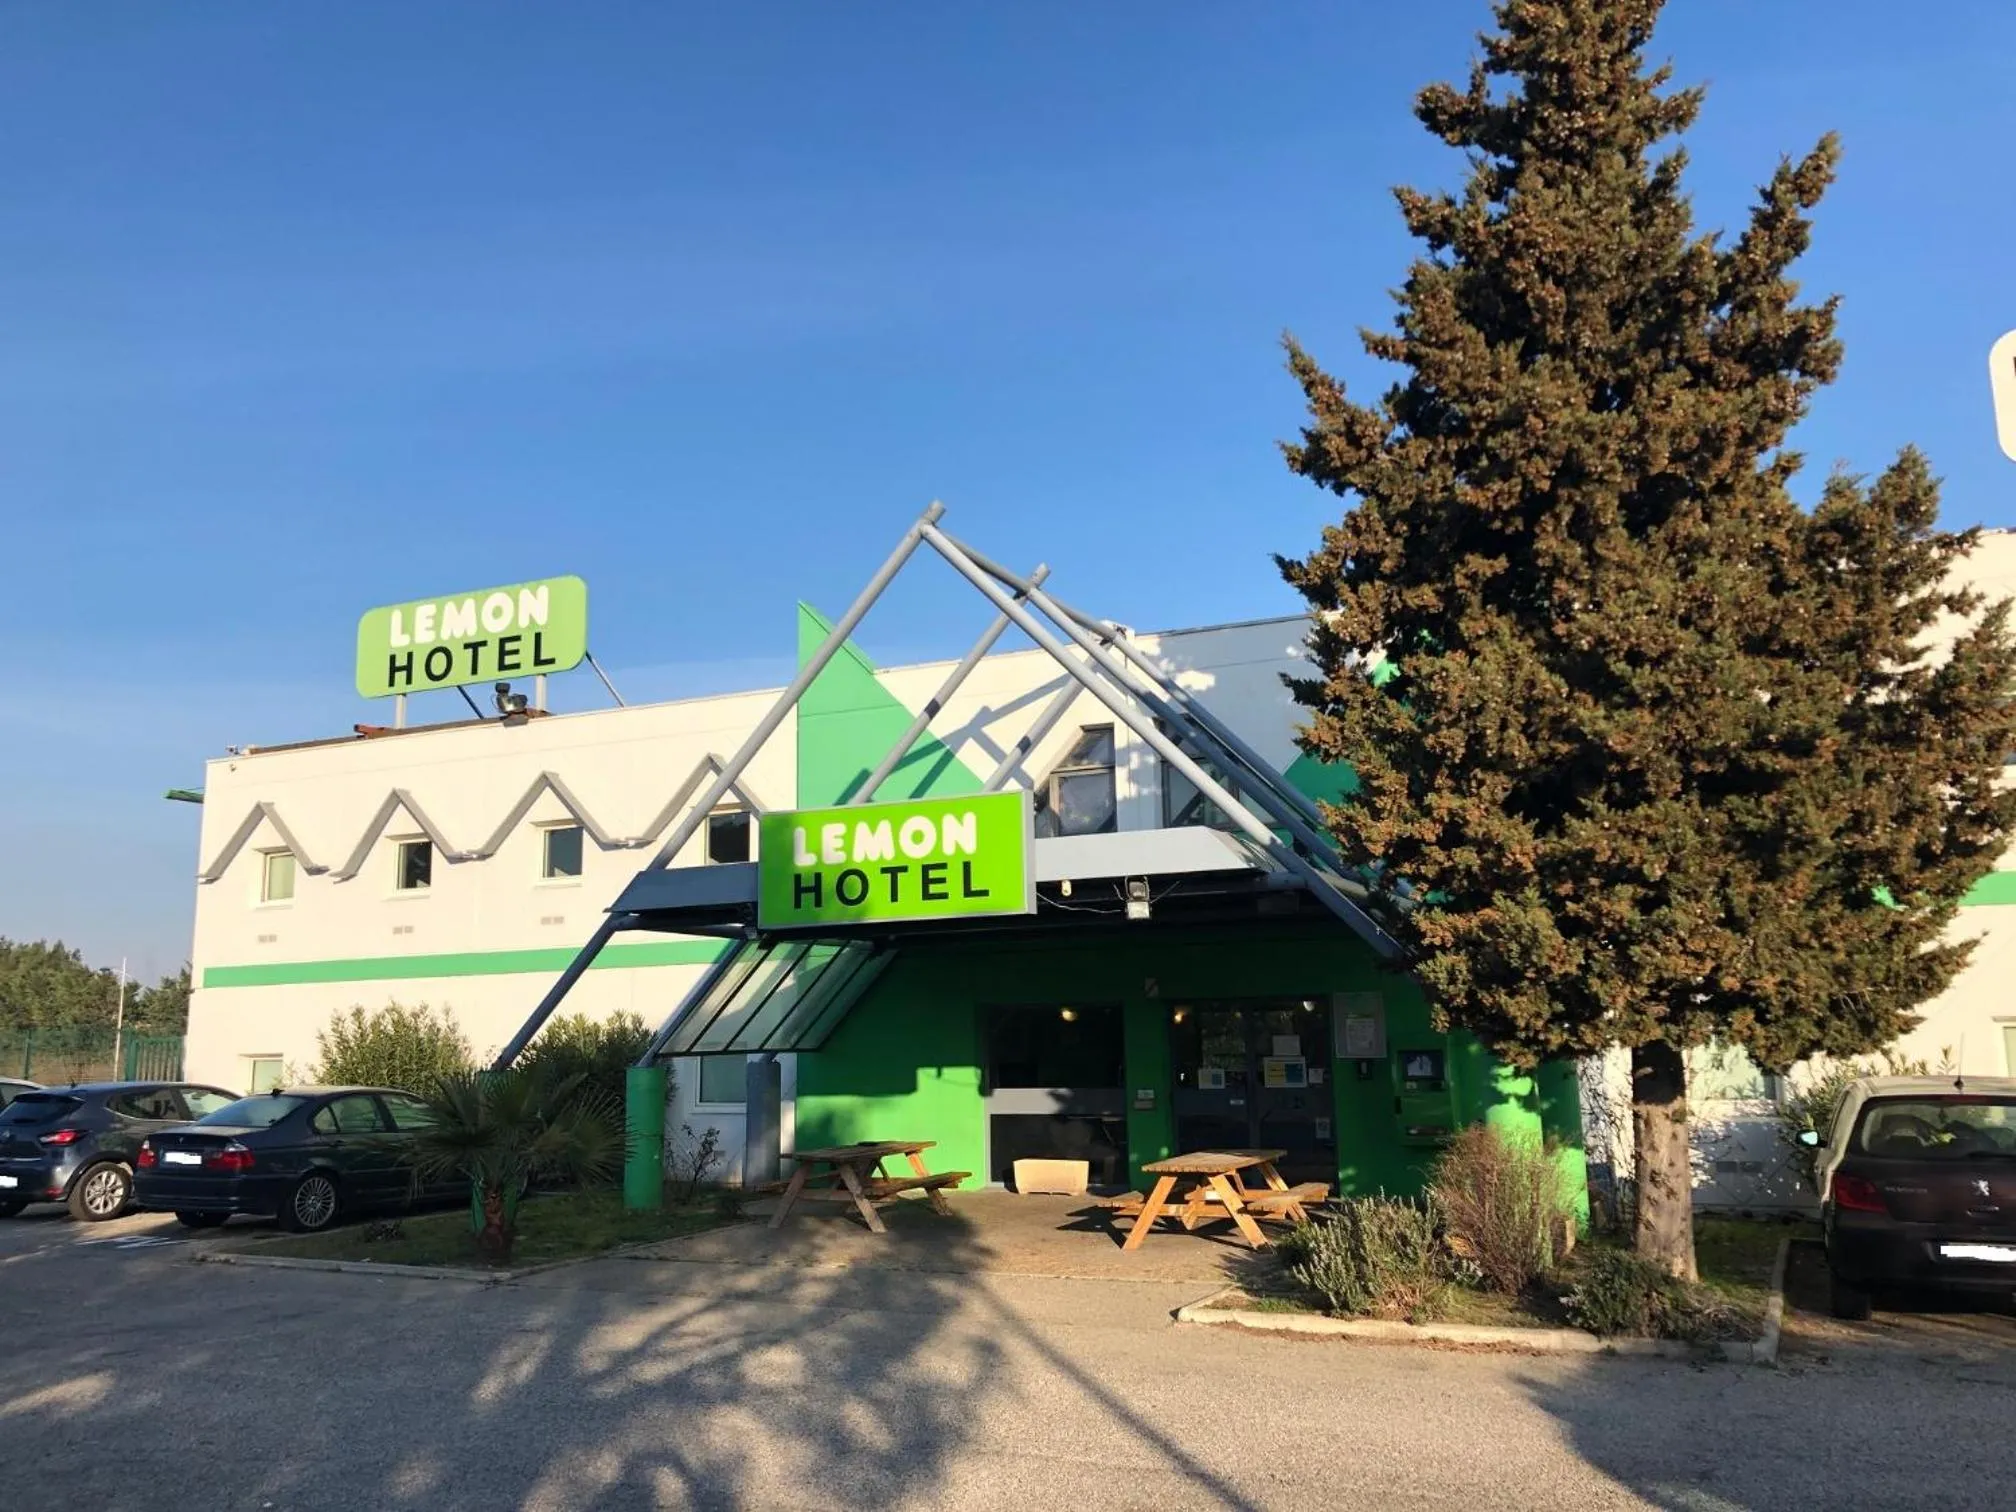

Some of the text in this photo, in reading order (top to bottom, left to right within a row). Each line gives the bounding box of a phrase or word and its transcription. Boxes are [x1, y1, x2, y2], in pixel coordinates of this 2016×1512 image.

[389, 585, 549, 648] LEMON
[388, 631, 556, 688] HOTEL
[793, 811, 977, 867] LEMON
[793, 860, 990, 910] HOTEL
